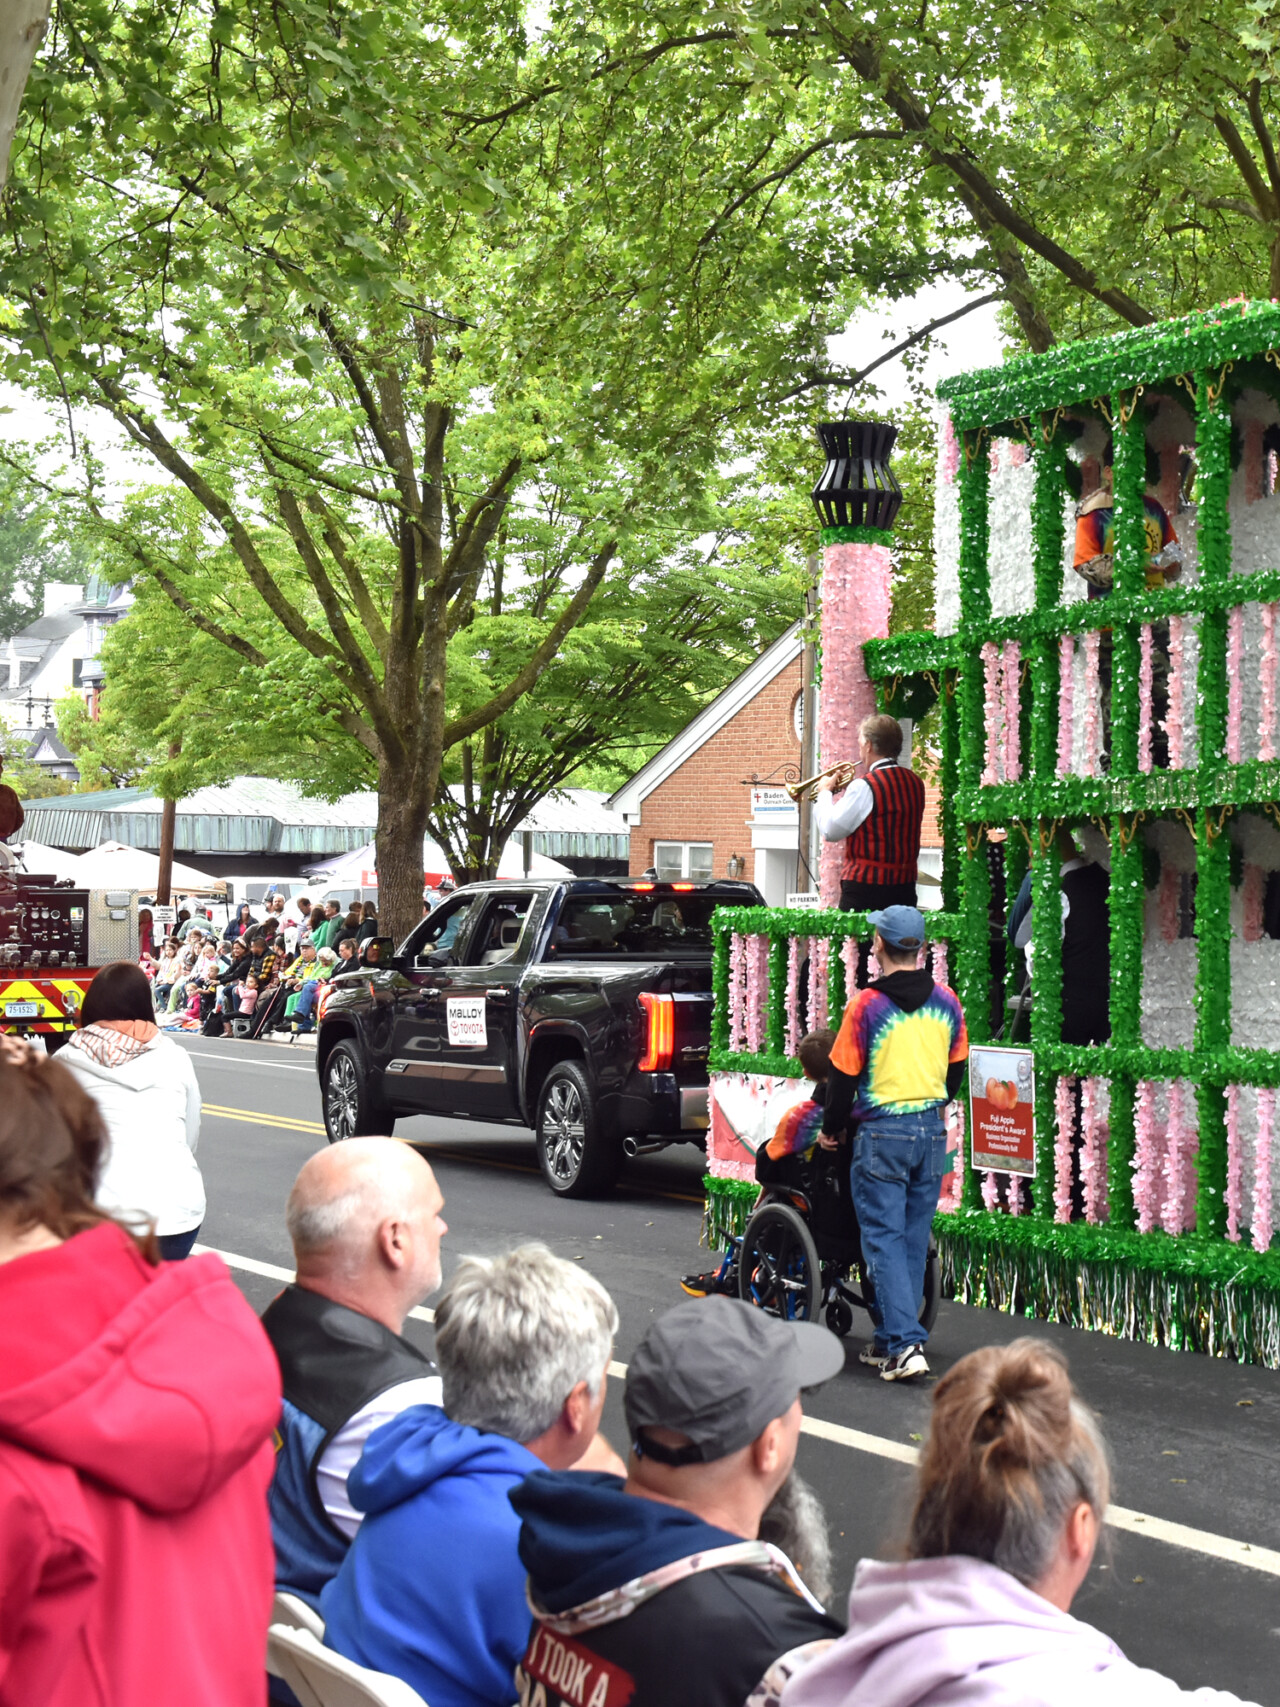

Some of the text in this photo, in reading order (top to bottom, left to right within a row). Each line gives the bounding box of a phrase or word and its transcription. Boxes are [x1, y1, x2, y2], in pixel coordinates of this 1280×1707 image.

[460, 1023, 484, 1034] TOYOTA
[980, 1122, 1026, 1135] President's Award
[528, 1627, 543, 1666] I
[539, 1633, 593, 1705] TOOK
[586, 1671, 610, 1707] A
